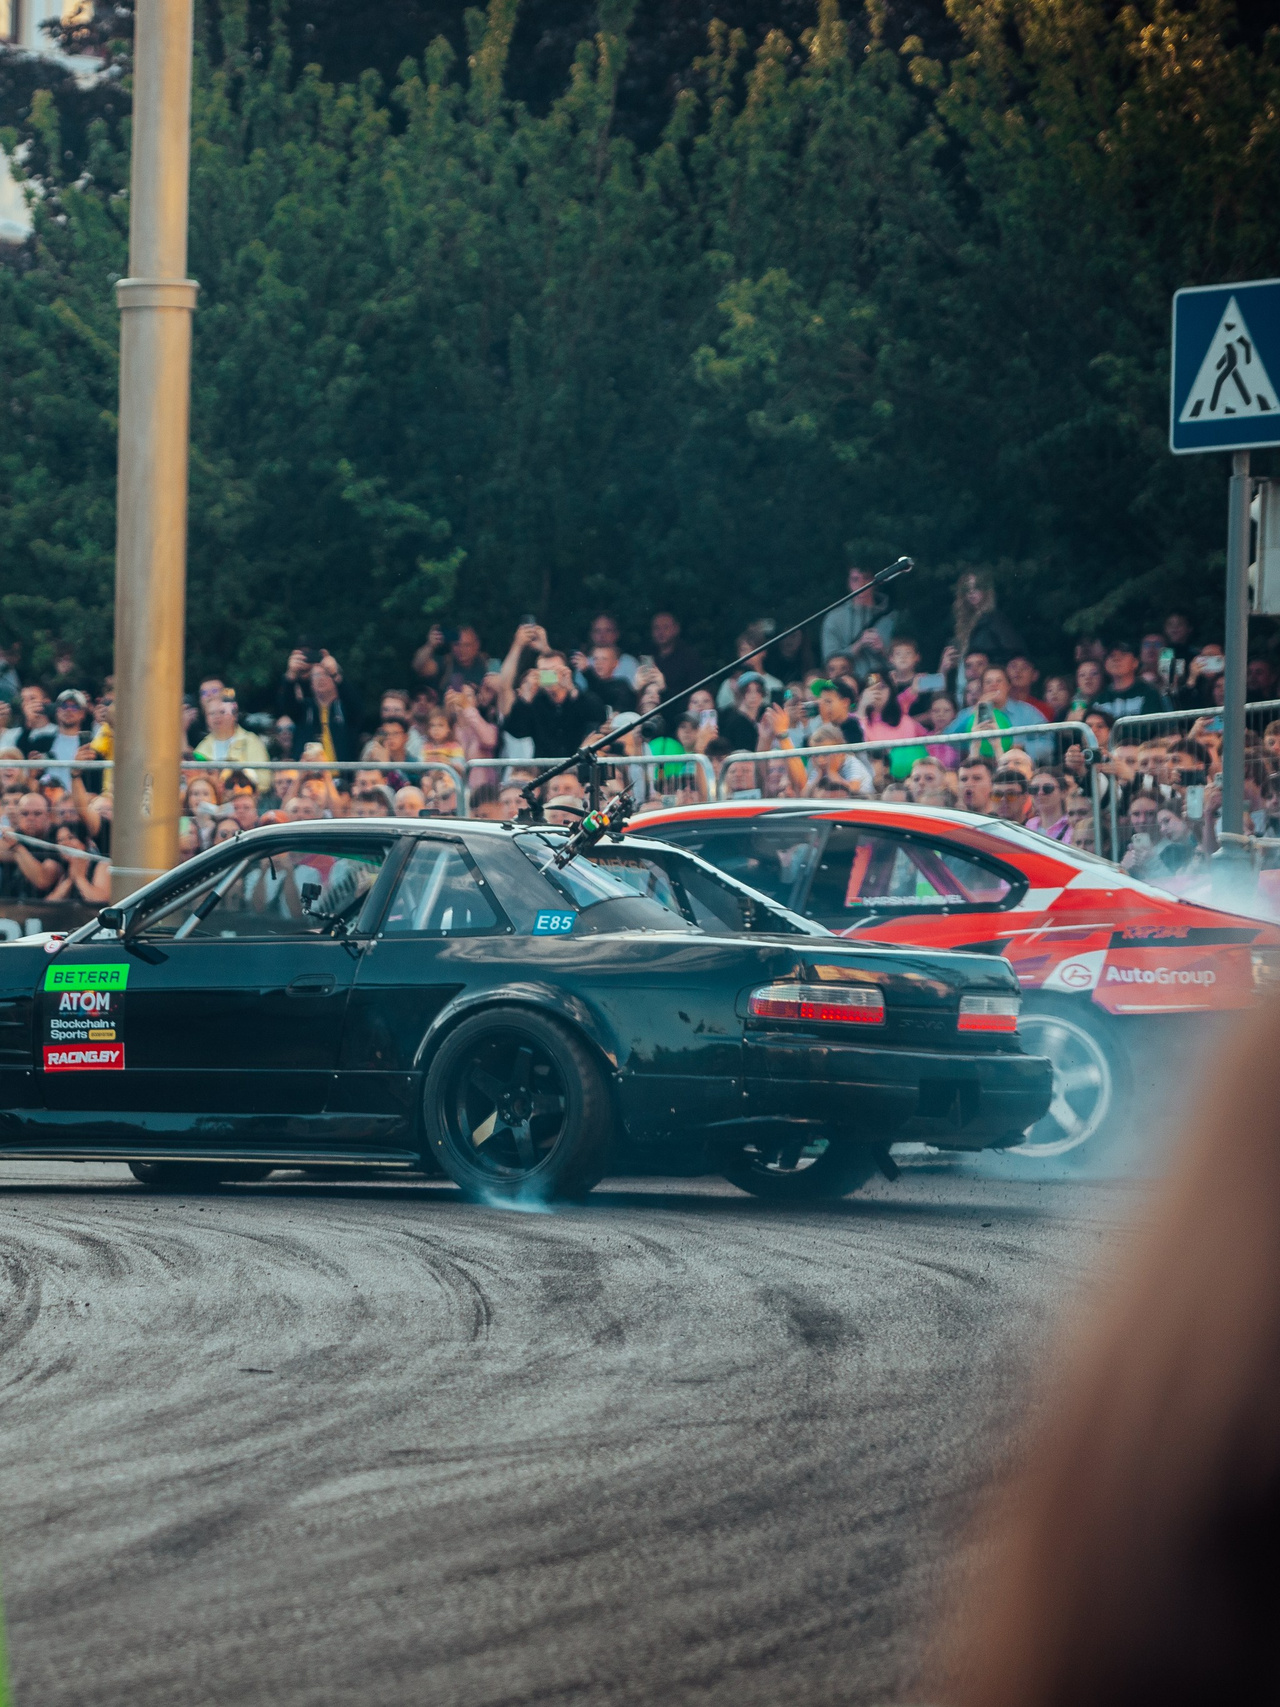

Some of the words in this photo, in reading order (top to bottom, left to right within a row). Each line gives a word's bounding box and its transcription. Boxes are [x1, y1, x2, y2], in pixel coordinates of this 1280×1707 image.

[536, 915, 573, 930] E85
[53, 971, 121, 984] BET.ERA
[1106, 965, 1216, 987] AutoGroup
[58, 992, 110, 1011] ATOM
[50, 1019, 109, 1029] Blockchain
[50, 1029, 88, 1041] Sports
